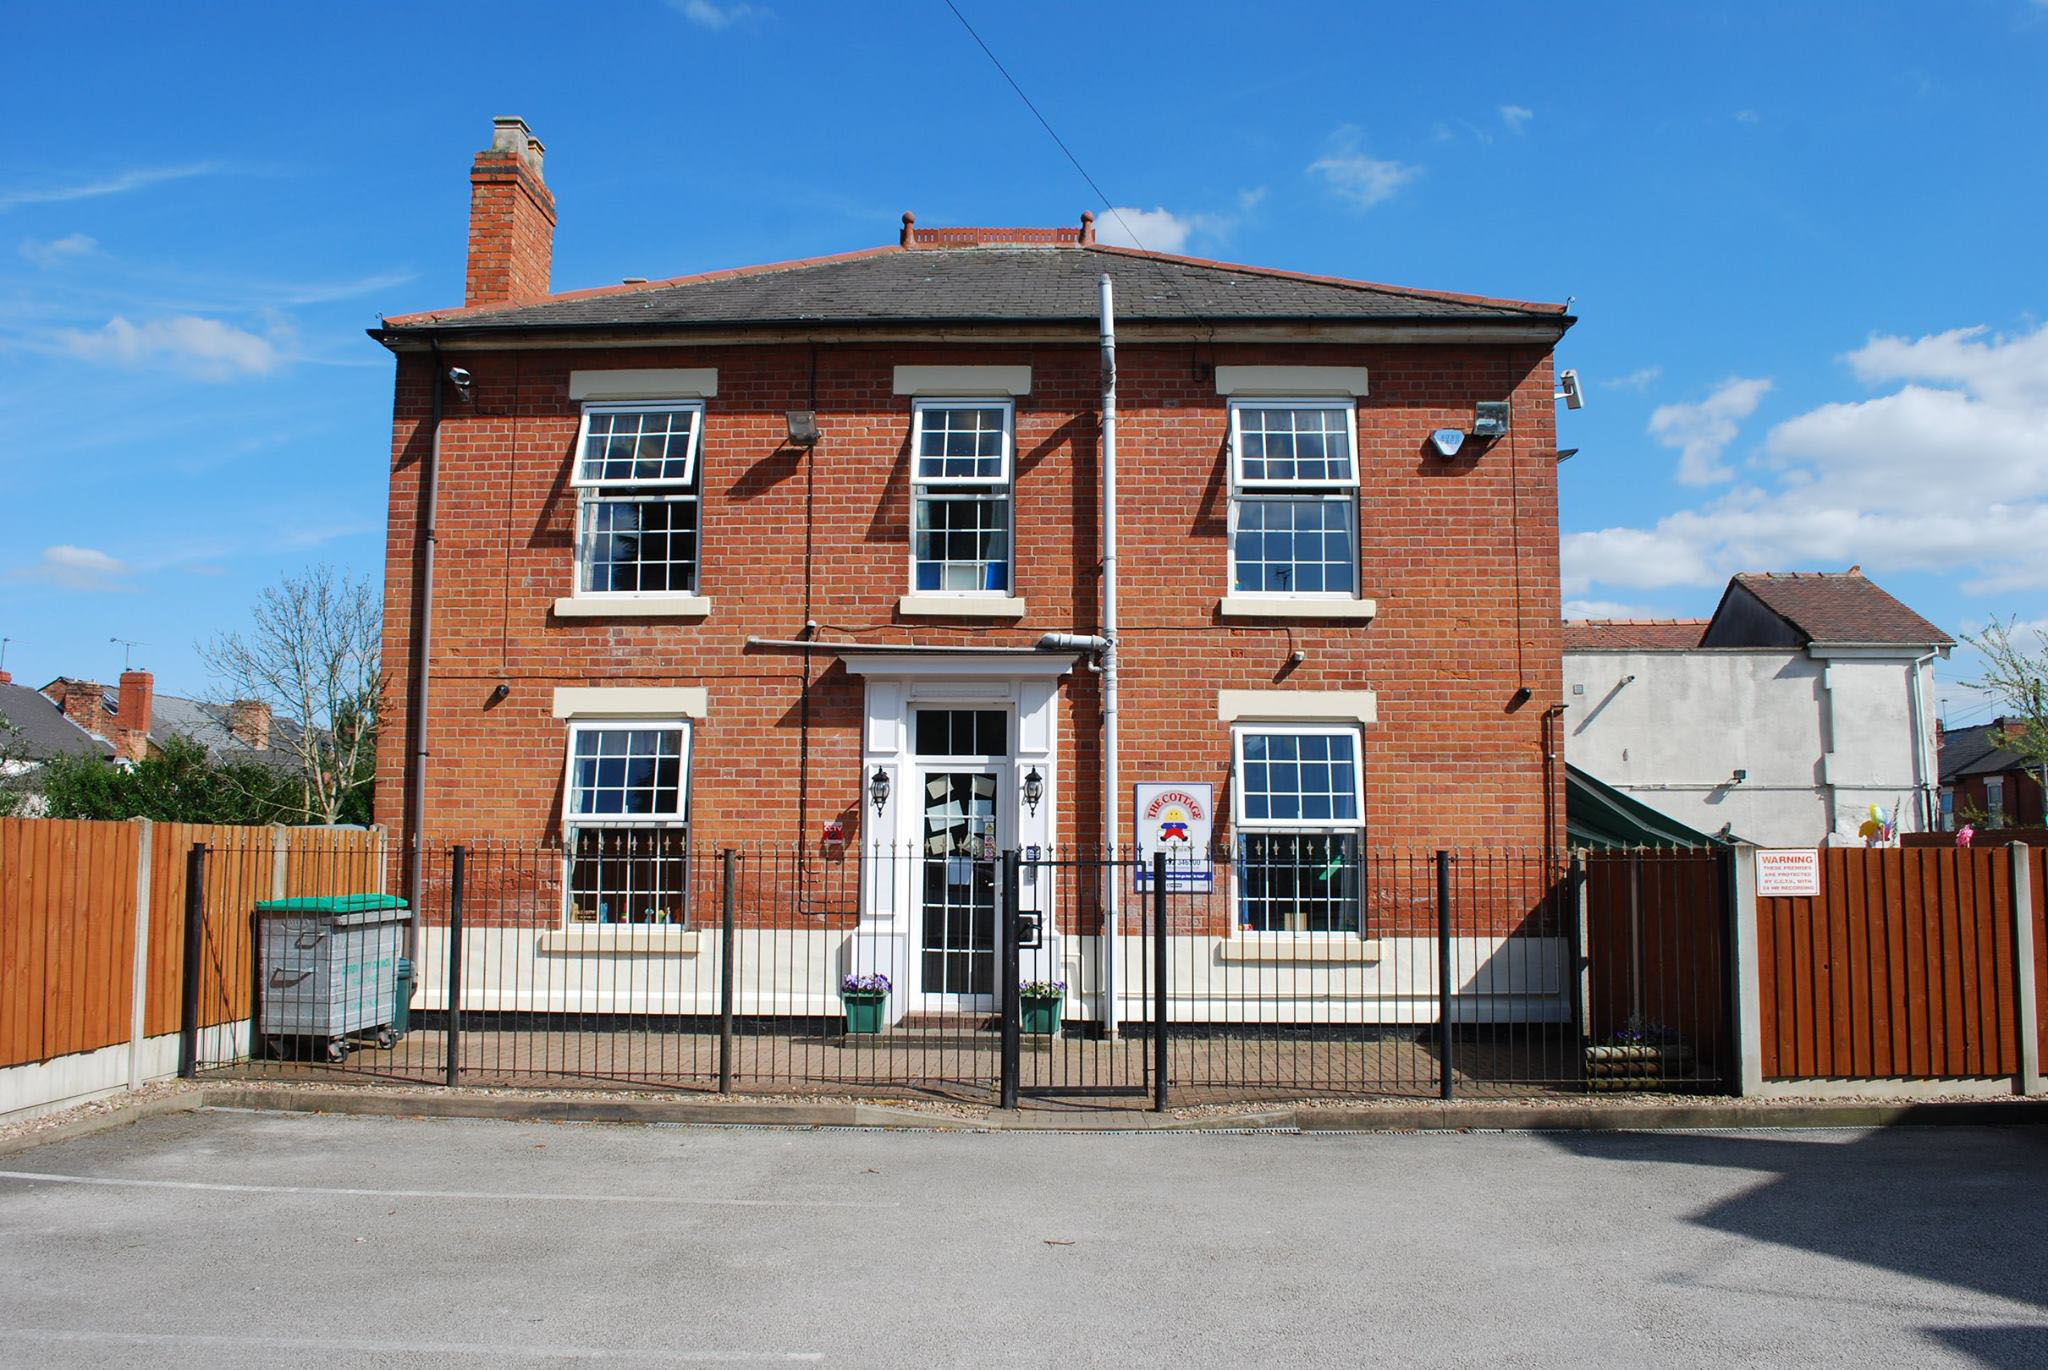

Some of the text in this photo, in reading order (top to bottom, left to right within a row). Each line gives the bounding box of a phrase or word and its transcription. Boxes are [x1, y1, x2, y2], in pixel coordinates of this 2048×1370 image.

[1148, 793, 1202, 820] THE COTTAGE
[1761, 856, 1813, 864] WARNING
